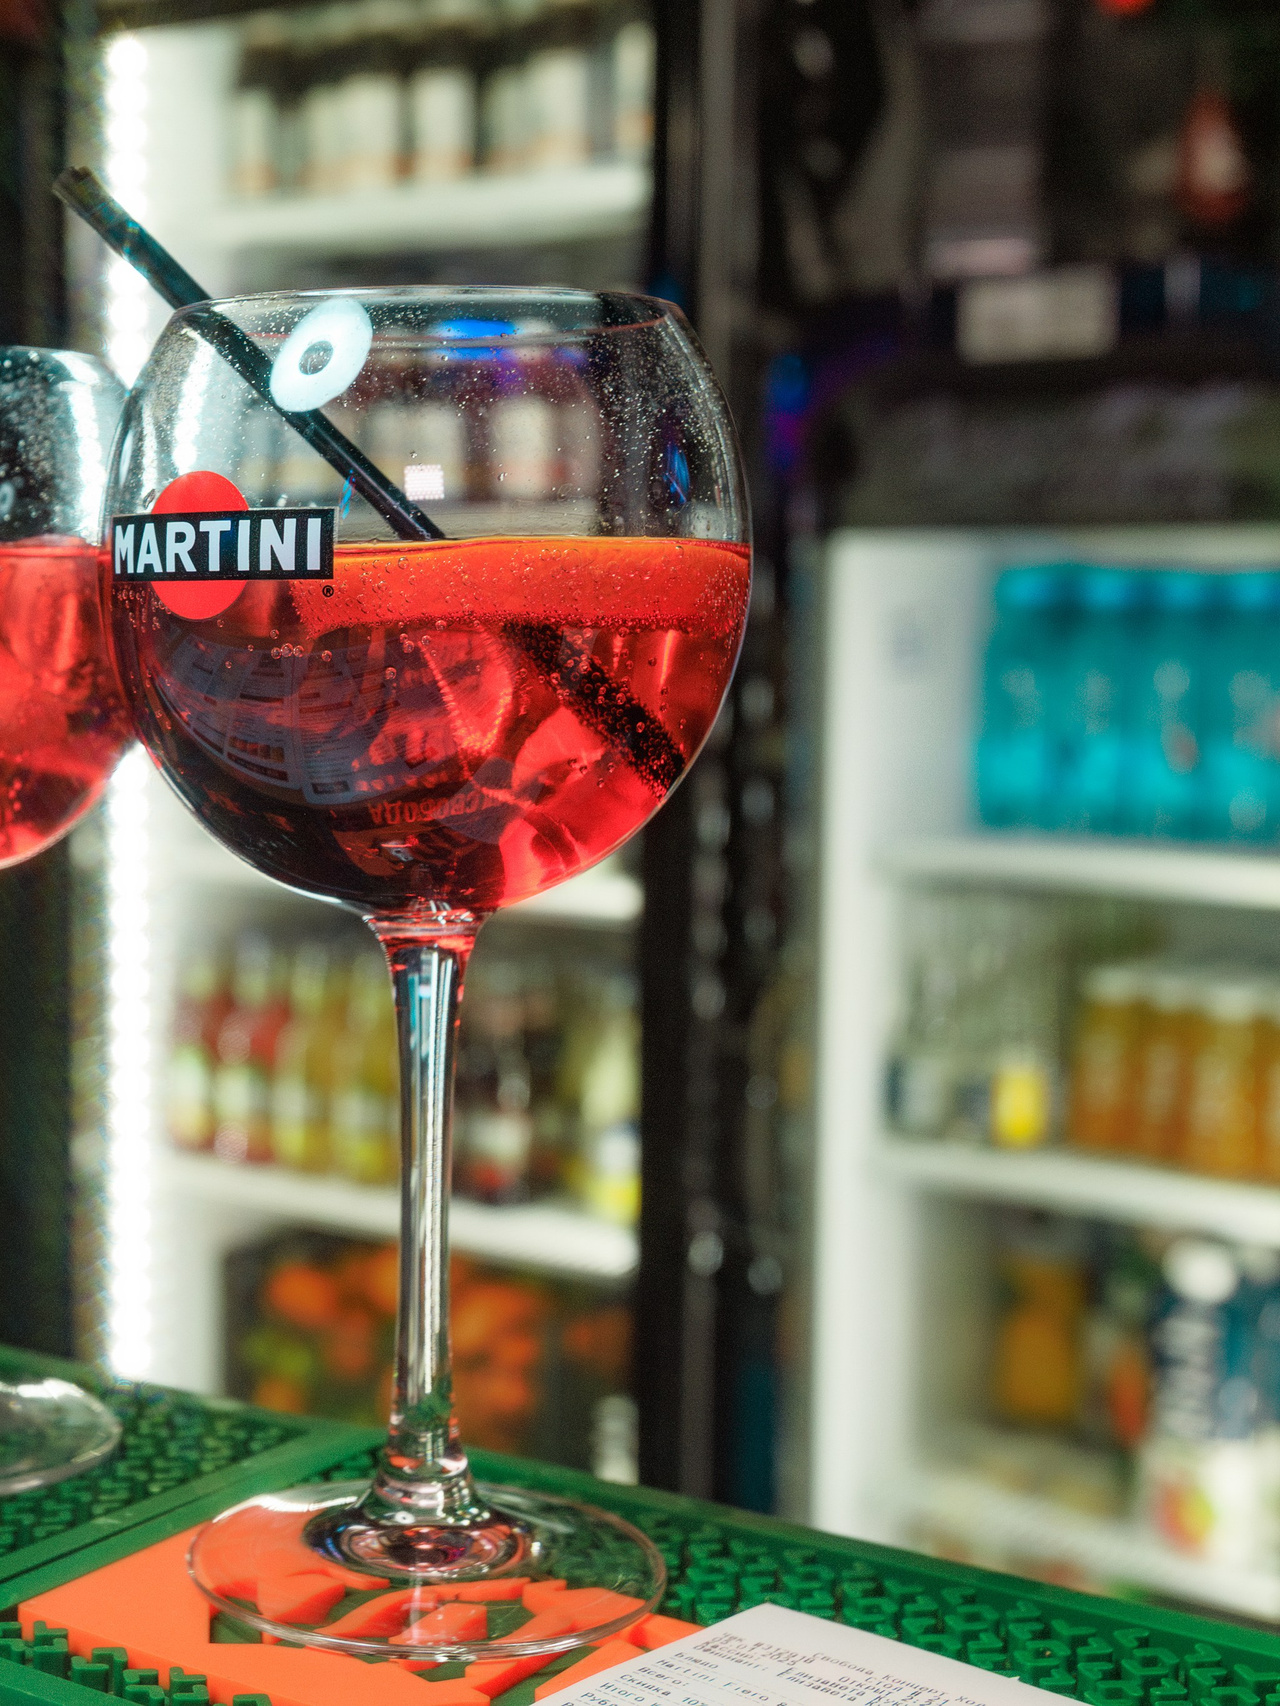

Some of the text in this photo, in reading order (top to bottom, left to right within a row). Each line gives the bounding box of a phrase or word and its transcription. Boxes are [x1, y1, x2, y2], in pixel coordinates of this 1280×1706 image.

[115, 518, 322, 575] MARTINI
[620, 1674, 671, 1697] Скидка
[637, 1666, 690, 1687] Всего:
[656, 1659, 717, 1682] Martini
[723, 1681, 770, 1702] Fiero
[812, 1652, 875, 1676] Свобода
[881, 1674, 950, 1697] Концерт
[599, 1682, 646, 1702] Итого
